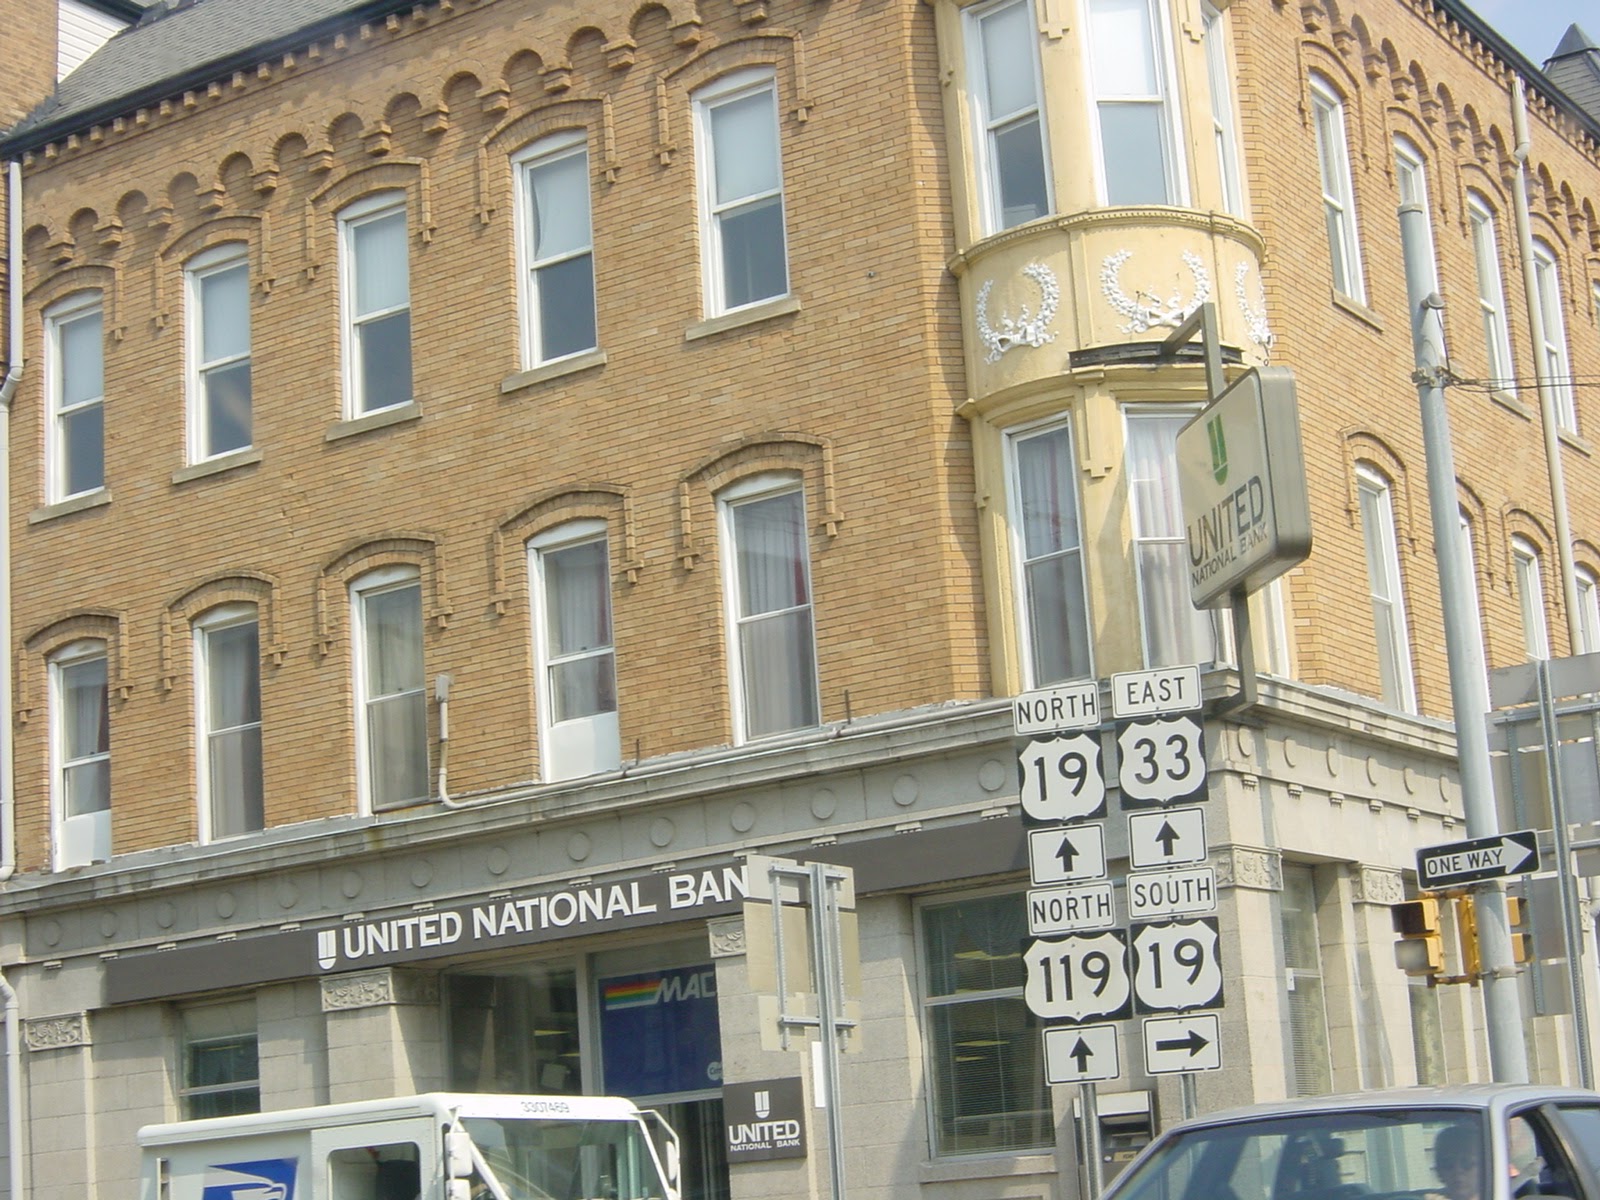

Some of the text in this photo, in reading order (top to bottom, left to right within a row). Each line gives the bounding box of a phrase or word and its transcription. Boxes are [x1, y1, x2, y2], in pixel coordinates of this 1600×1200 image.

[1187, 475, 1264, 567] UNITED
[1192, 521, 1268, 587] NATIONAL BANK
[1126, 676, 1186, 706] EAST
[1017, 692, 1096, 725] NORTH
[1133, 733, 1191, 785] 33
[1033, 751, 1088, 802] 19
[1427, 848, 1503, 876] ONE WAY
[1032, 892, 1112, 925] NORTH
[1133, 876, 1212, 908] SOUTH
[343, 865, 750, 960] UNITED NATIONAL BAN
[1039, 950, 1111, 1003] 119
[1148, 938, 1205, 990] 19
[655, 970, 717, 1004] MAC
[728, 1119, 801, 1145] UNITED
[730, 1138, 801, 1152] NATIONAL BANK
